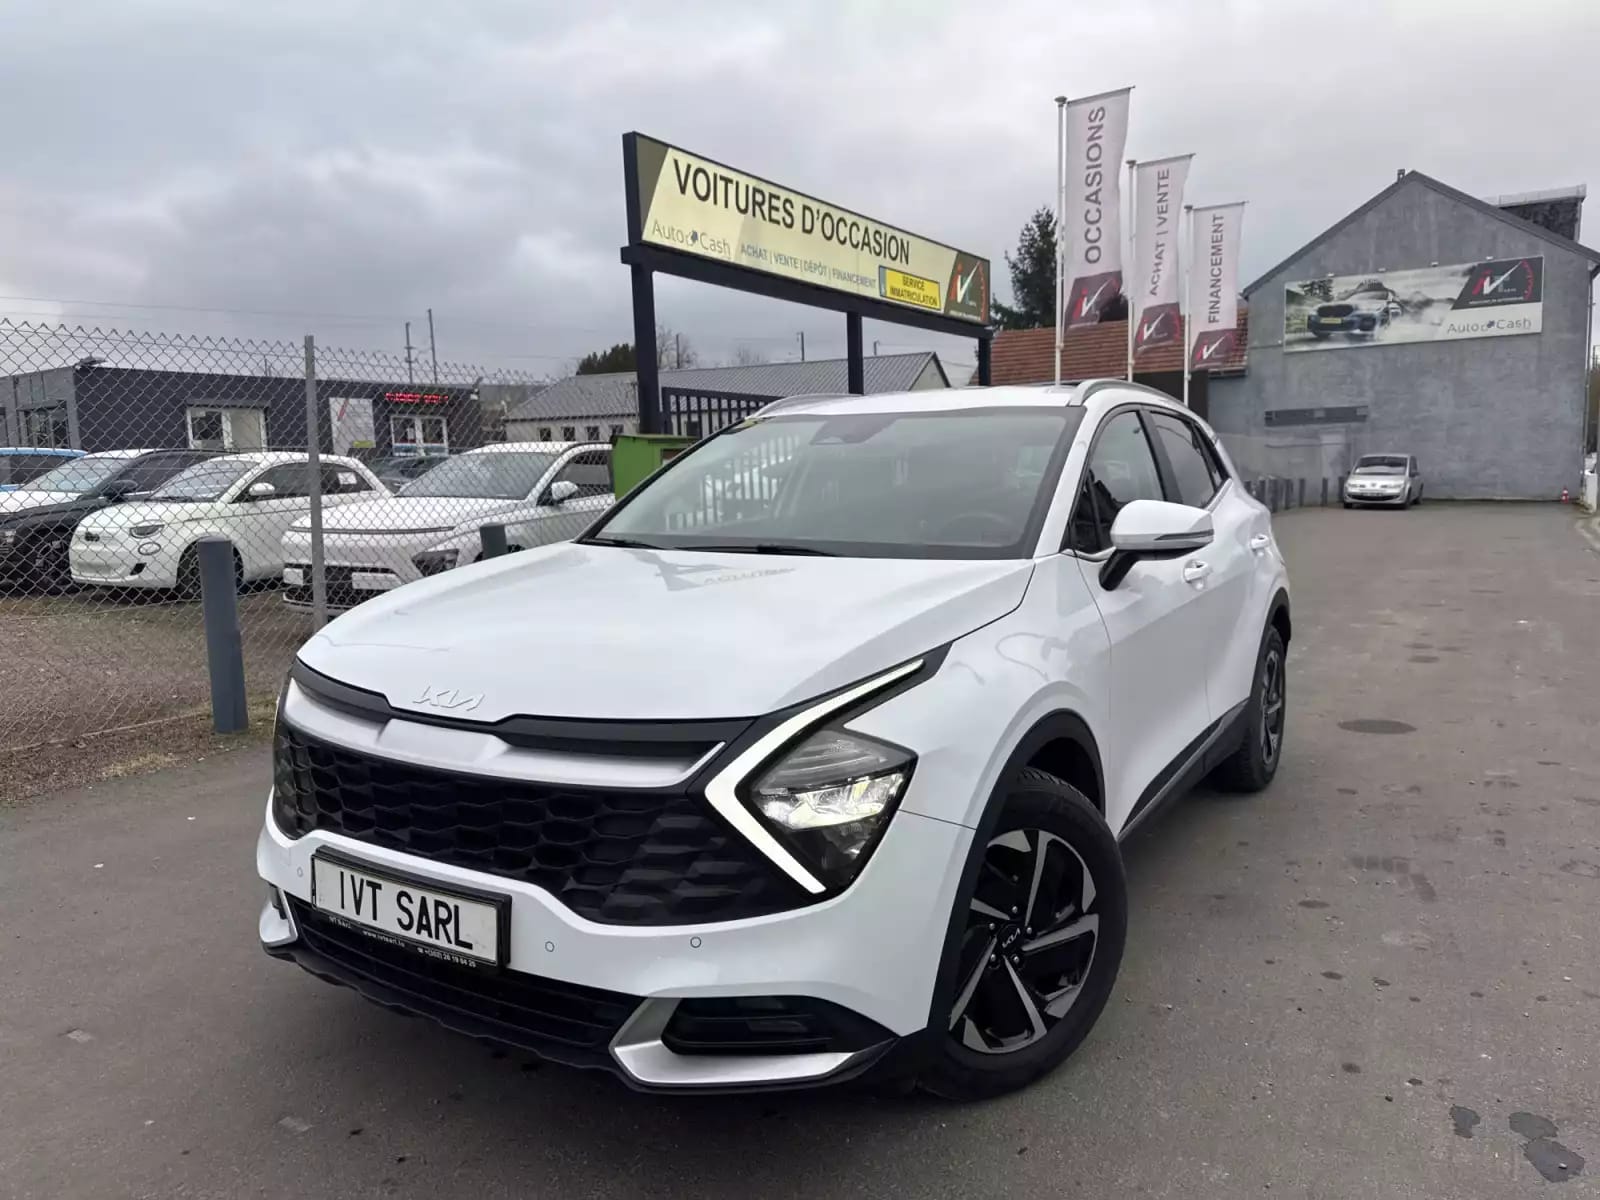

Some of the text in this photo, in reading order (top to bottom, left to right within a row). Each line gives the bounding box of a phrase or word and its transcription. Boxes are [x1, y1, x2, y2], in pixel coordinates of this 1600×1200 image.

[673, 158, 911, 266] VOITURES D'OCCASION
[1084, 106, 1106, 264] OCCASIONS
[652, 220, 731, 256] Auto Cash
[1150, 168, 1170, 296] ACHAT VENTE
[741, 244, 768, 260] ACHAT
[773, 253, 799, 269] VENTE
[833, 269, 877, 286] FINANCEMENT
[902, 275, 925, 291] SERVICE
[1207, 213, 1225, 323] FINANCEMENT
[1447, 317, 1532, 334] Auto Cash
[396, 890, 473, 950] SARL
